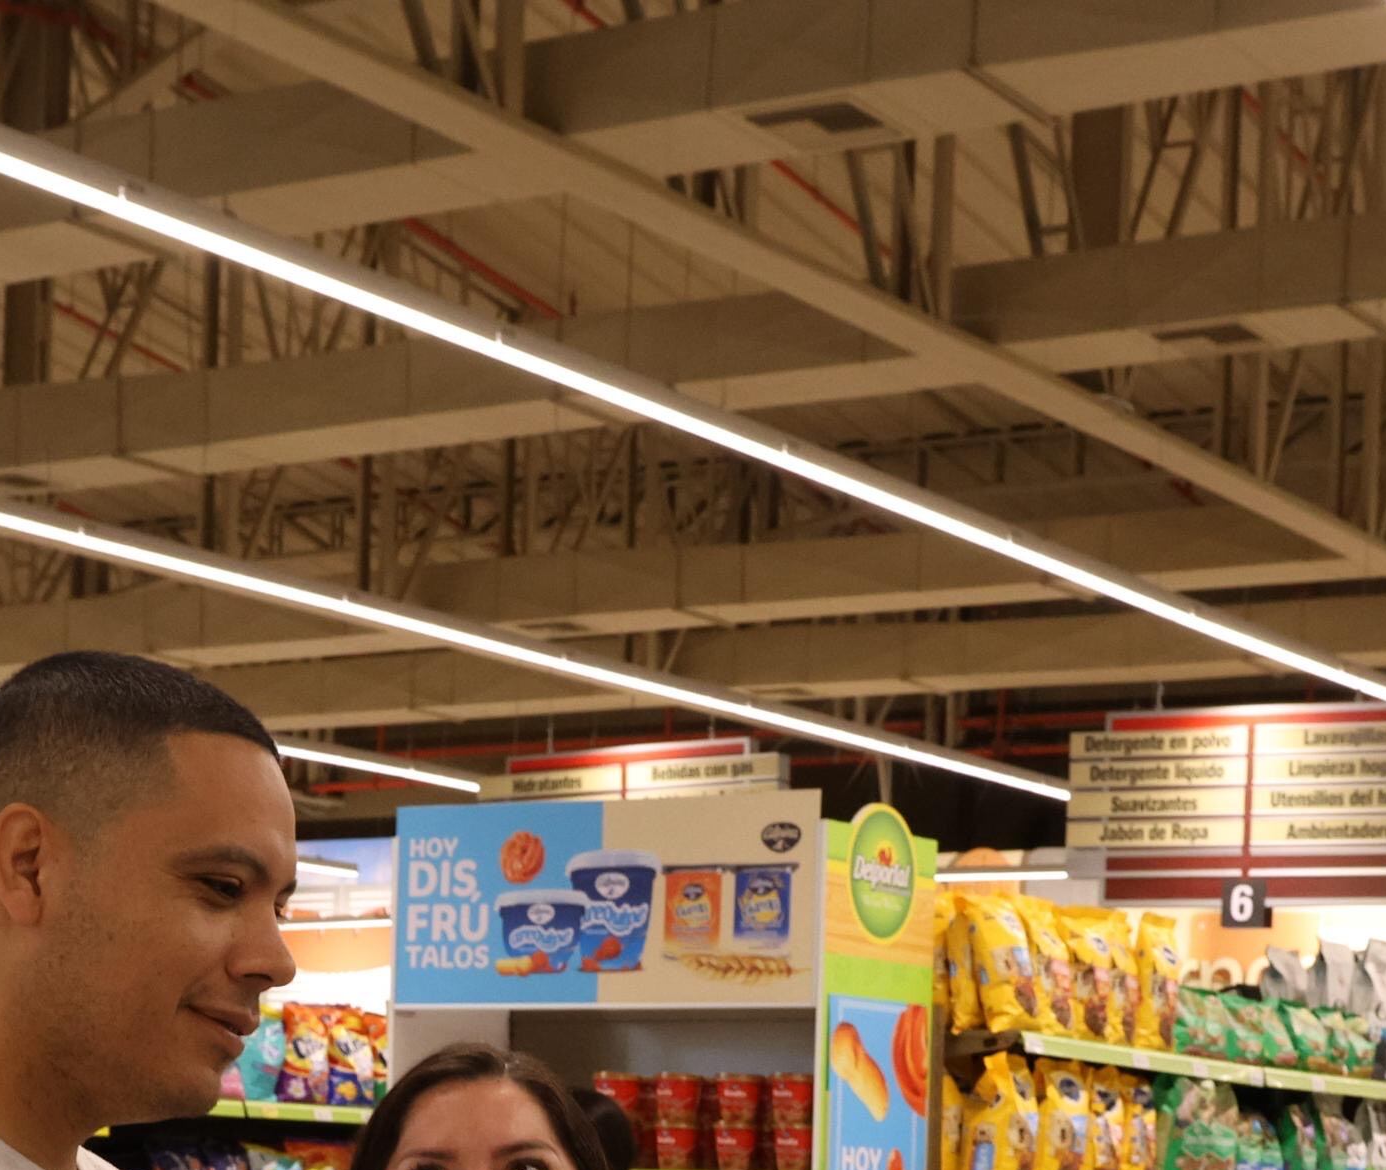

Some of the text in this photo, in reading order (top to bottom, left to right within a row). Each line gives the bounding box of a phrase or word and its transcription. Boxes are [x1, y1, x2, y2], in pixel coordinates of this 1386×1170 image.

[1085, 734, 1231, 755] Detergente en polvo
[651, 761, 754, 781] Bebidas con gas
[1089, 765, 1169, 786] Detergente
[1288, 759, 1355, 782] Limpieza
[1110, 796, 1197, 813] Suavizantes
[1349, 789, 1373, 807] del
[1148, 825, 1167, 841] de
[1171, 823, 1209, 843] Ropa
[409, 837, 459, 858] HOY
[1229, 884, 1254, 922] 6
[404, 945, 490, 970] TALOS
